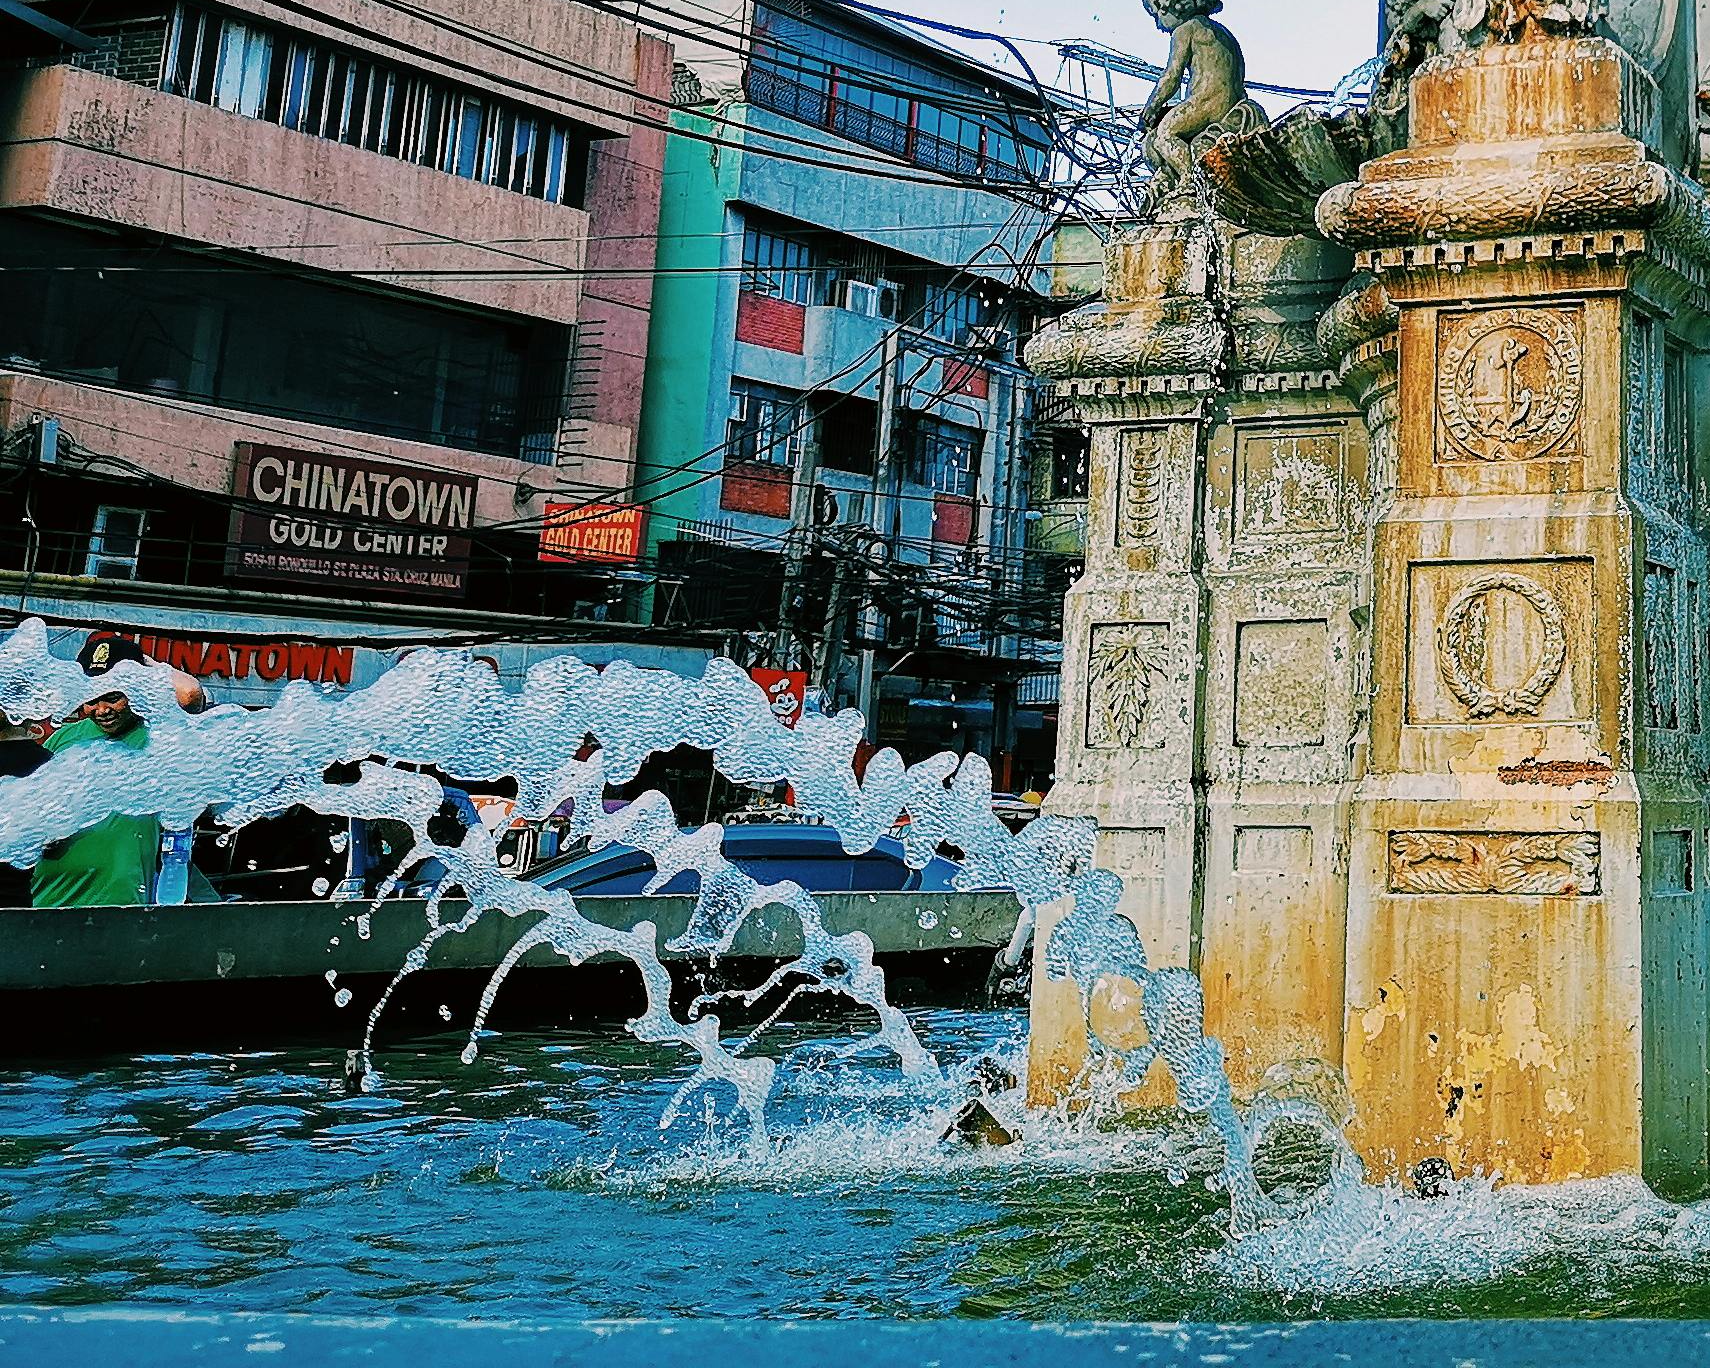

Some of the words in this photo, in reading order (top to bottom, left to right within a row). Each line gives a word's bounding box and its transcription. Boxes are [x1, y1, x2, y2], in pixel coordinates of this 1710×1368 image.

[252, 456, 473, 529] CHINATOWN
[269, 513, 343, 550] GOLD
[353, 523, 448, 561] CENTER
[545, 527, 580, 554] GOLD
[583, 527, 633, 556] CENTER
[89, 631, 355, 684] INATOWN
